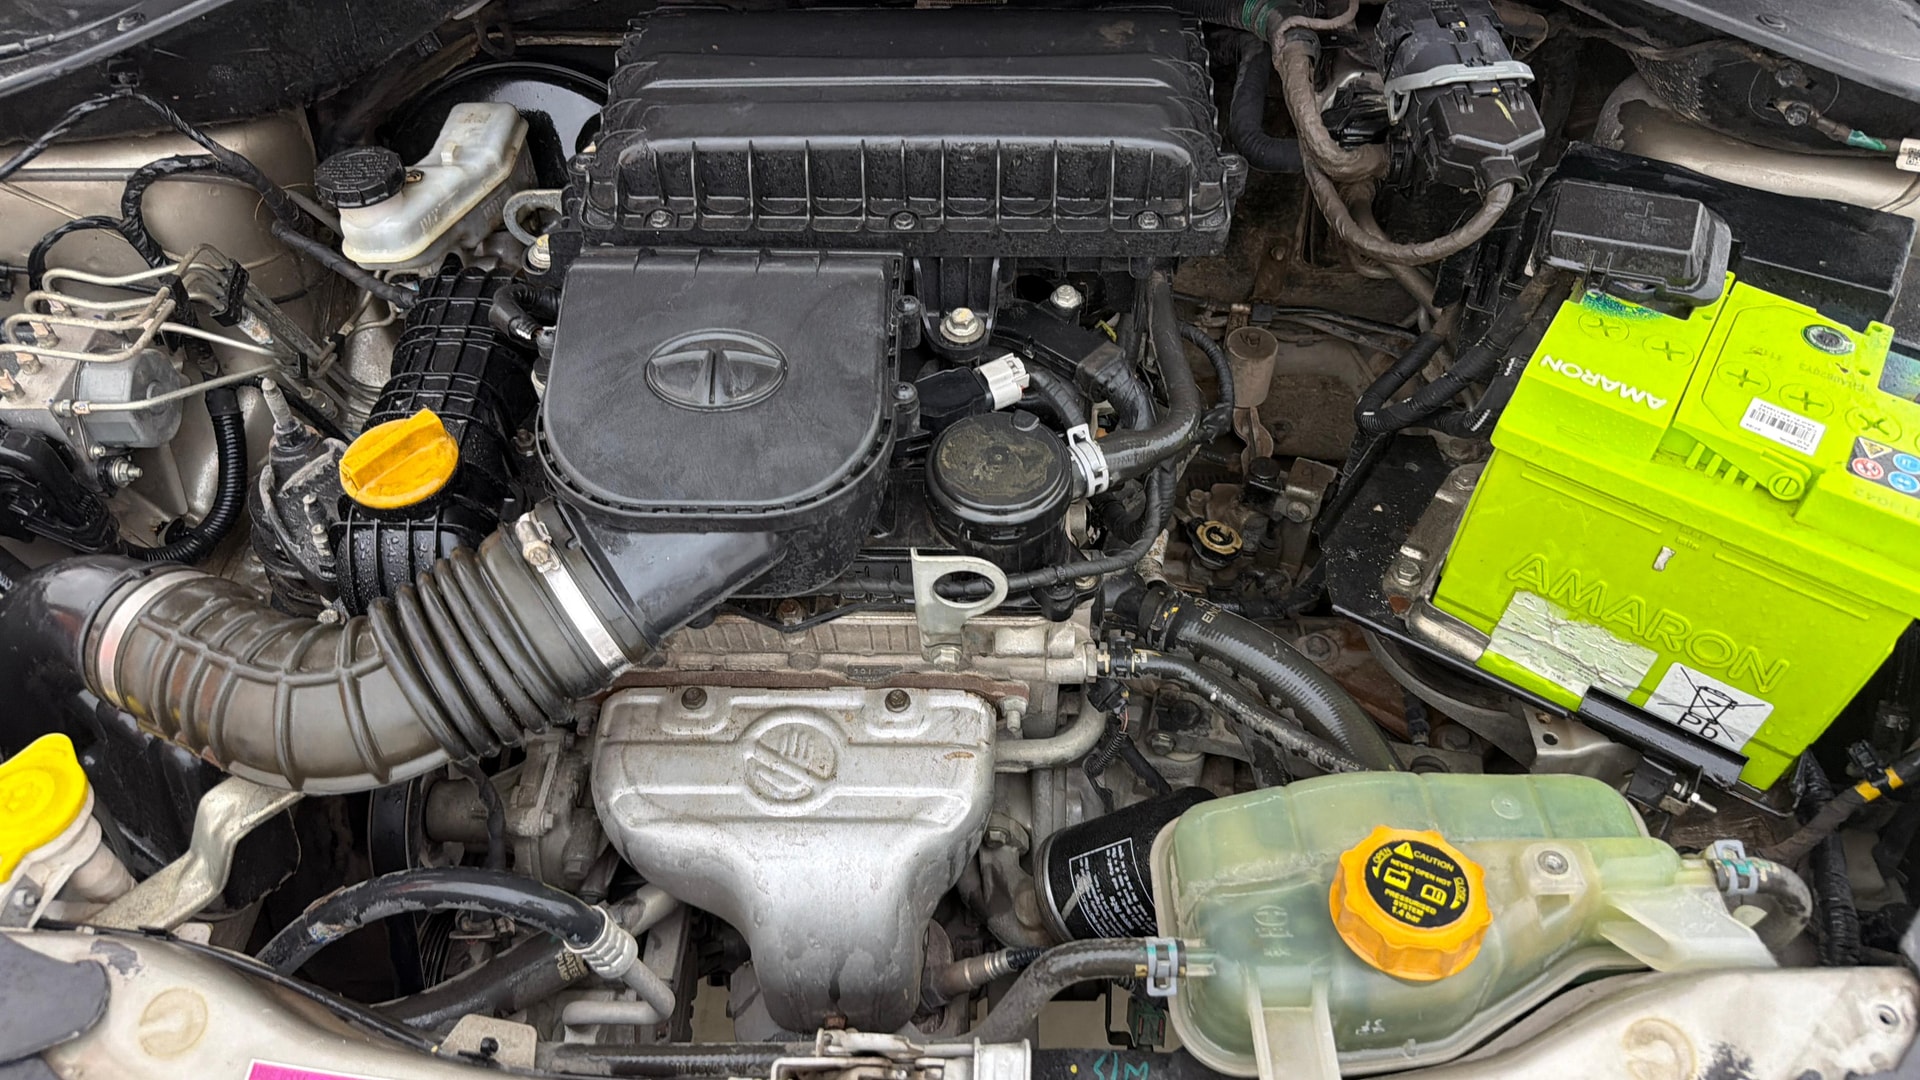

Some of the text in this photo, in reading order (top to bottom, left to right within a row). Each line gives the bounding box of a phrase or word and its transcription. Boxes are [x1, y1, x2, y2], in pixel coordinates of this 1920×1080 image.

[1538, 354, 1668, 411] AMARON
[1506, 552, 1790, 694] AMARON
[1677, 711, 1719, 740] Pb
[1372, 847, 1394, 864] OPEN
[1413, 851, 1455, 873] CAUTION
[1390, 858, 1453, 887] NEVER OPEN HOT
[1384, 888, 1437, 915] PRESSURISED
[1393, 899, 1425, 917] SYSTEM
[1405, 911, 1422, 924] bar
